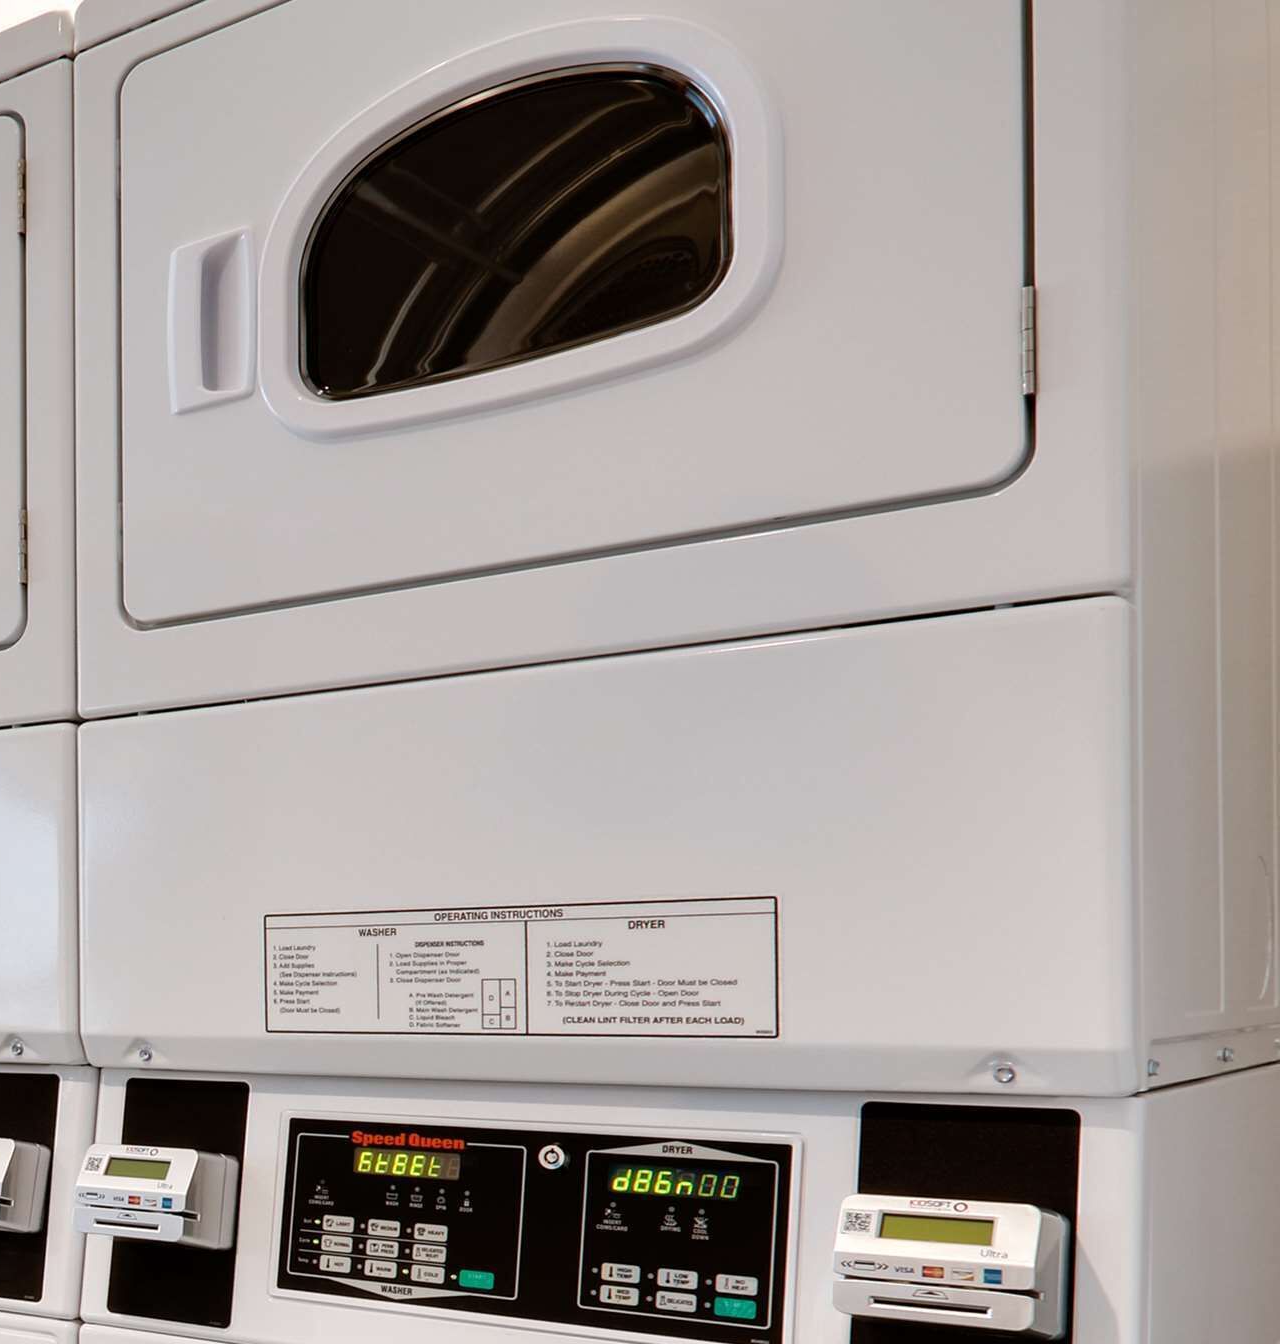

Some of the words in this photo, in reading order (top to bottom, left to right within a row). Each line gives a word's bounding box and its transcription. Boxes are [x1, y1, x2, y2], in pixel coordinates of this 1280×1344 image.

[434, 913, 488, 922] OPERATING
[491, 909, 563, 919] INSTRUCTIONS
[628, 920, 665, 929] DRYER
[358, 928, 397, 936] WASHER
[563, 1016, 596, 1024] (CLEAN
[714, 1017, 745, 1025] LOAD)
[352, 1130, 405, 1146] Speed
[408, 1133, 465, 1150] Queen
[662, 1145, 693, 1154] DRYER
[980, 1249, 1009, 1259] Ultra
[381, 1285, 413, 1296] WASHER
